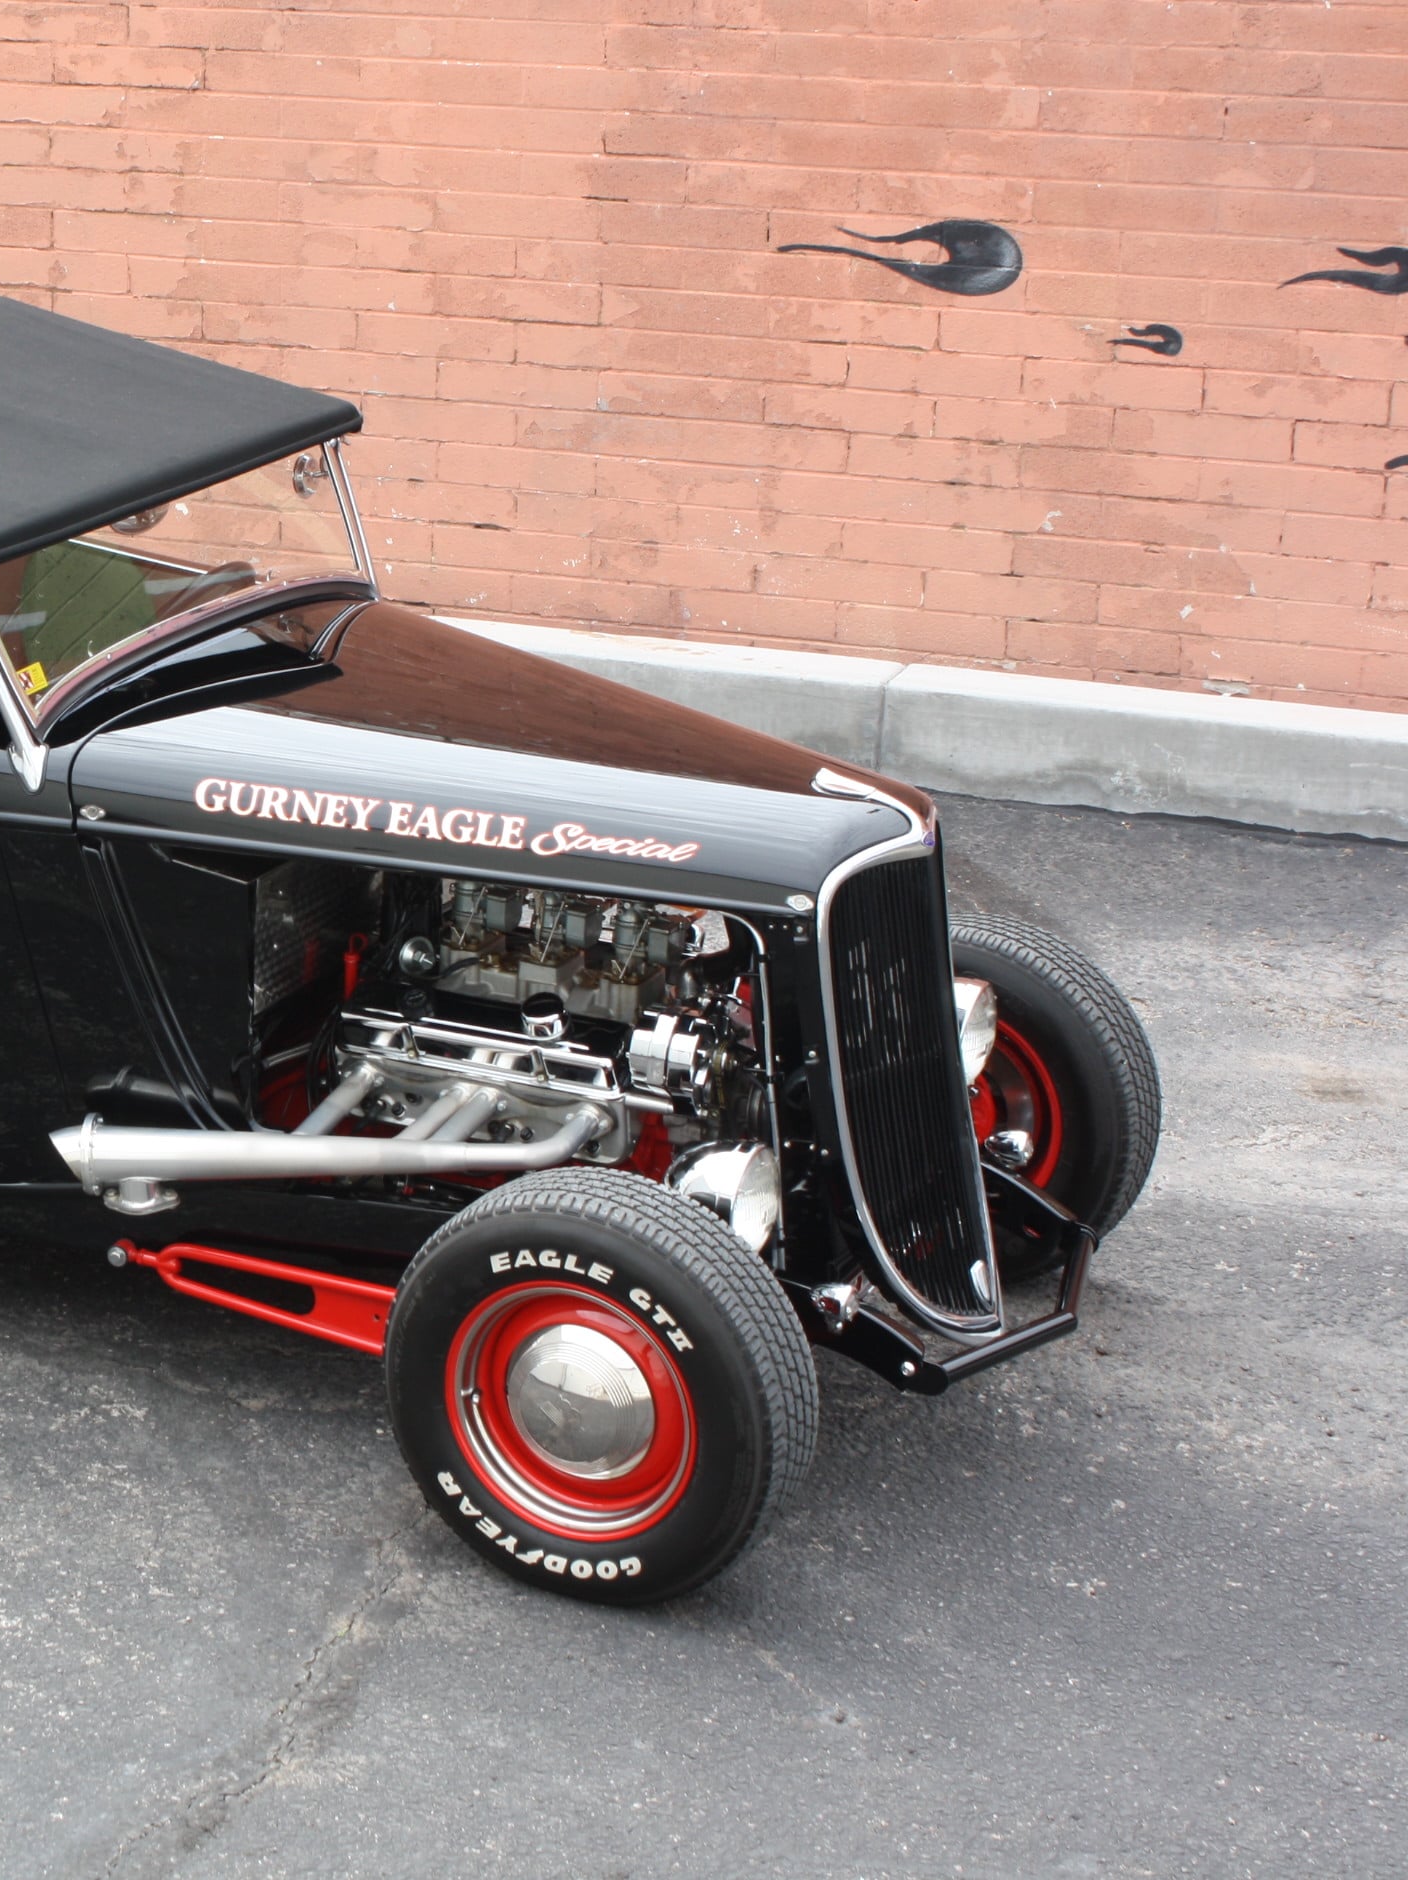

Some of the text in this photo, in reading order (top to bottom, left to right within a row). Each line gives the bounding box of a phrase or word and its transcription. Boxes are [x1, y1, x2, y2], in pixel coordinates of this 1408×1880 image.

[194, 777, 700, 863] GURNEY EAGLE Special
[489, 1249, 614, 1285] EAGLE
[437, 1471, 642, 1580] GOODYEAR
